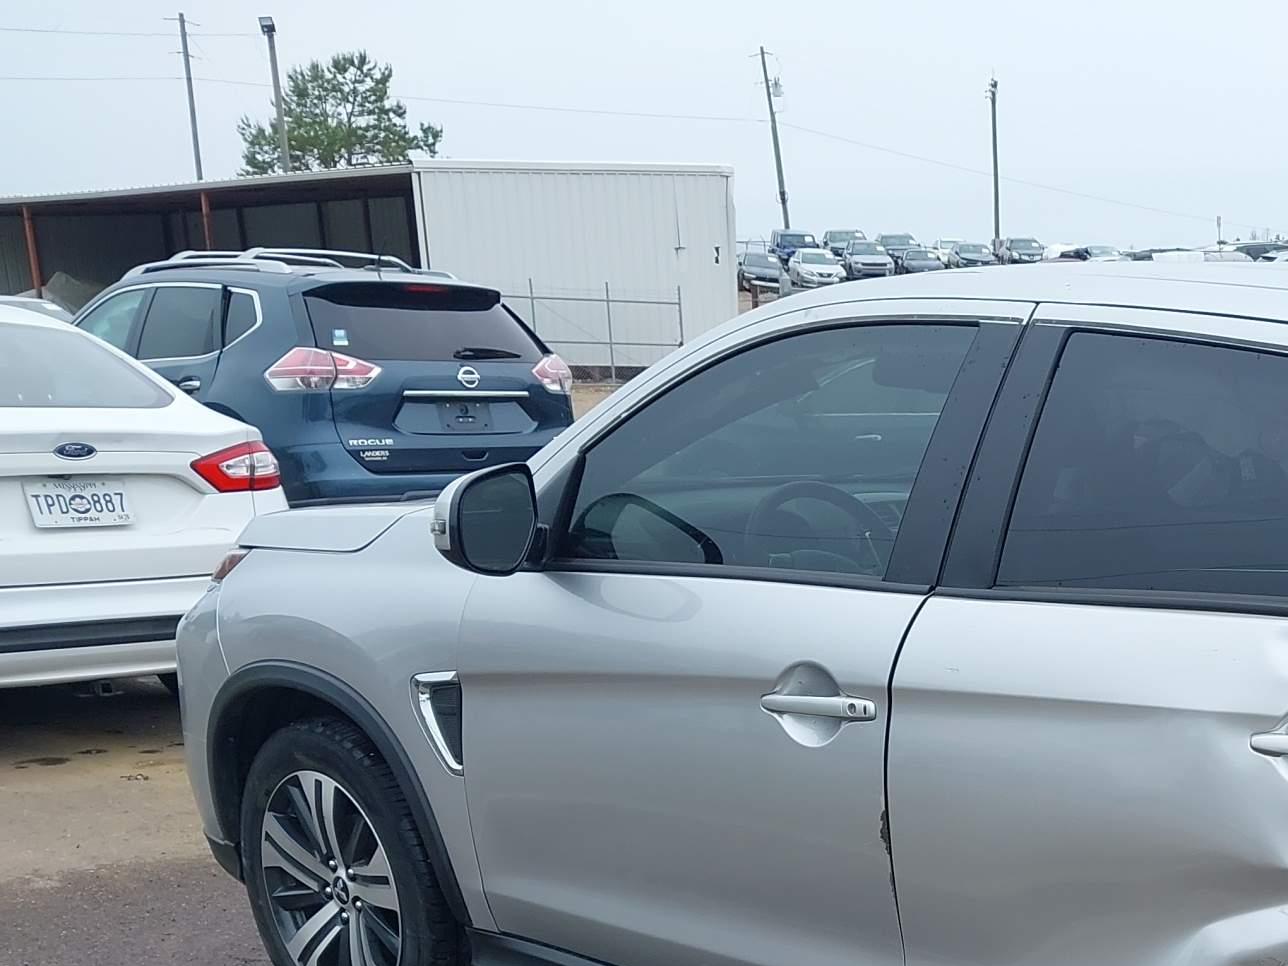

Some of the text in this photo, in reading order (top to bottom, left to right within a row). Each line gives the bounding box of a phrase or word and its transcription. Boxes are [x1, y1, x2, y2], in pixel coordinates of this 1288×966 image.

[348, 438, 393, 446] ROGUE
[63, 444, 89, 456] Ford
[30, 492, 125, 515] TPD 887
